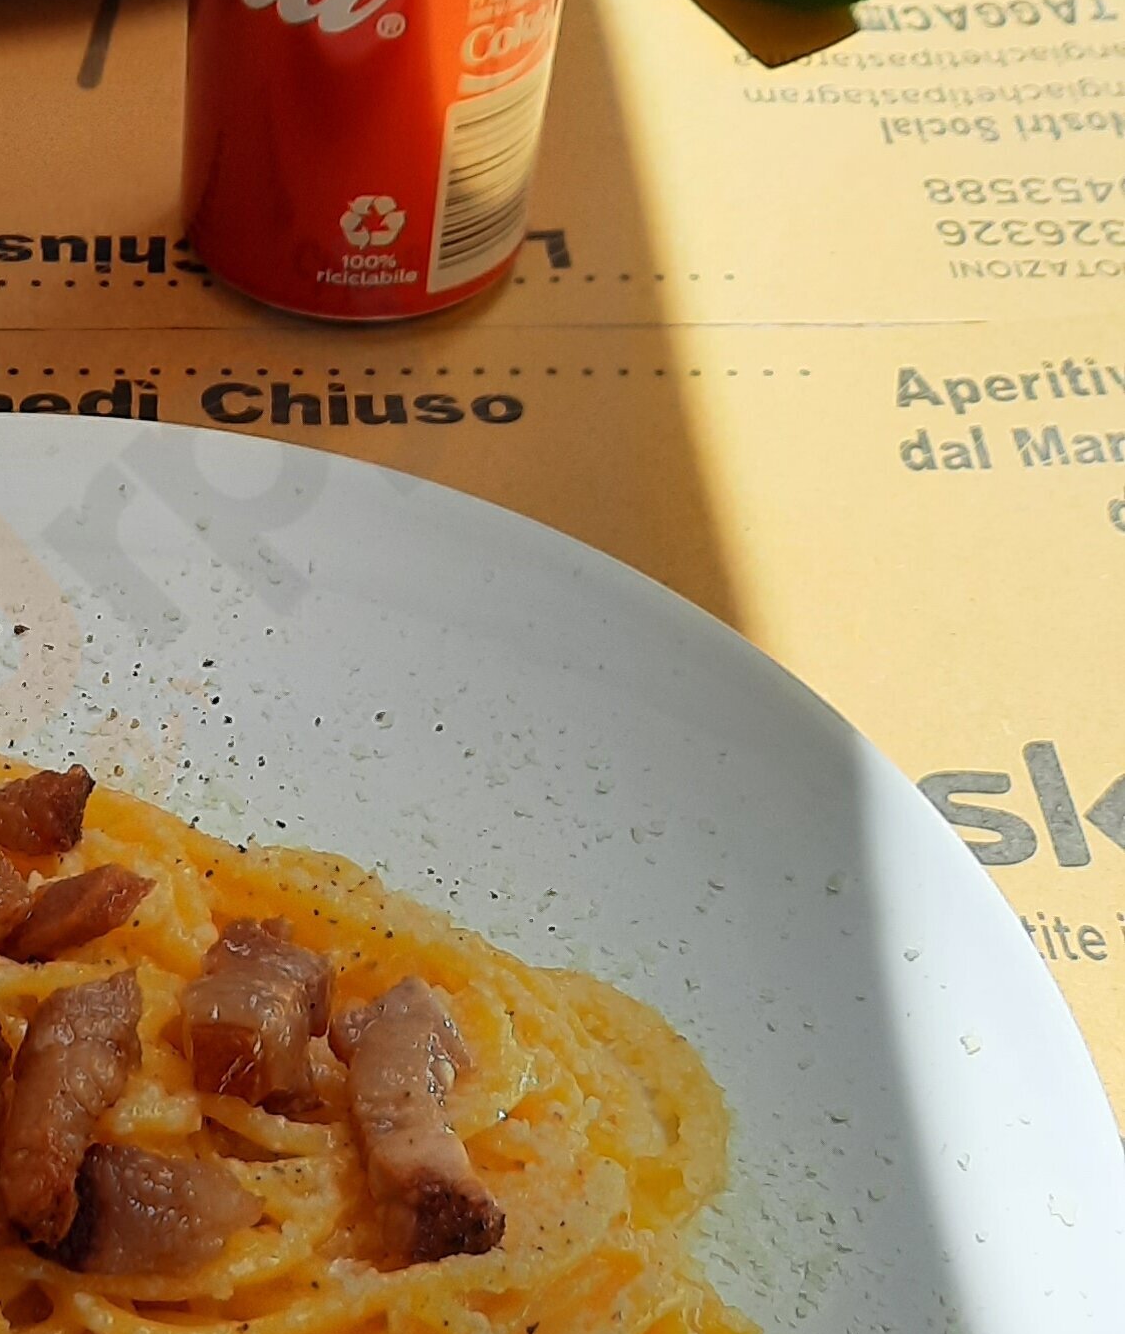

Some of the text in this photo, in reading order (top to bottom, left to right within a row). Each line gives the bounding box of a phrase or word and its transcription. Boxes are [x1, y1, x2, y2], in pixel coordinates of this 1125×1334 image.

[879, 115, 1001, 145] Social
[341, 253, 397, 268] 100%
[201, 382, 524, 425] Chiuso
[899, 424, 993, 472] dal
